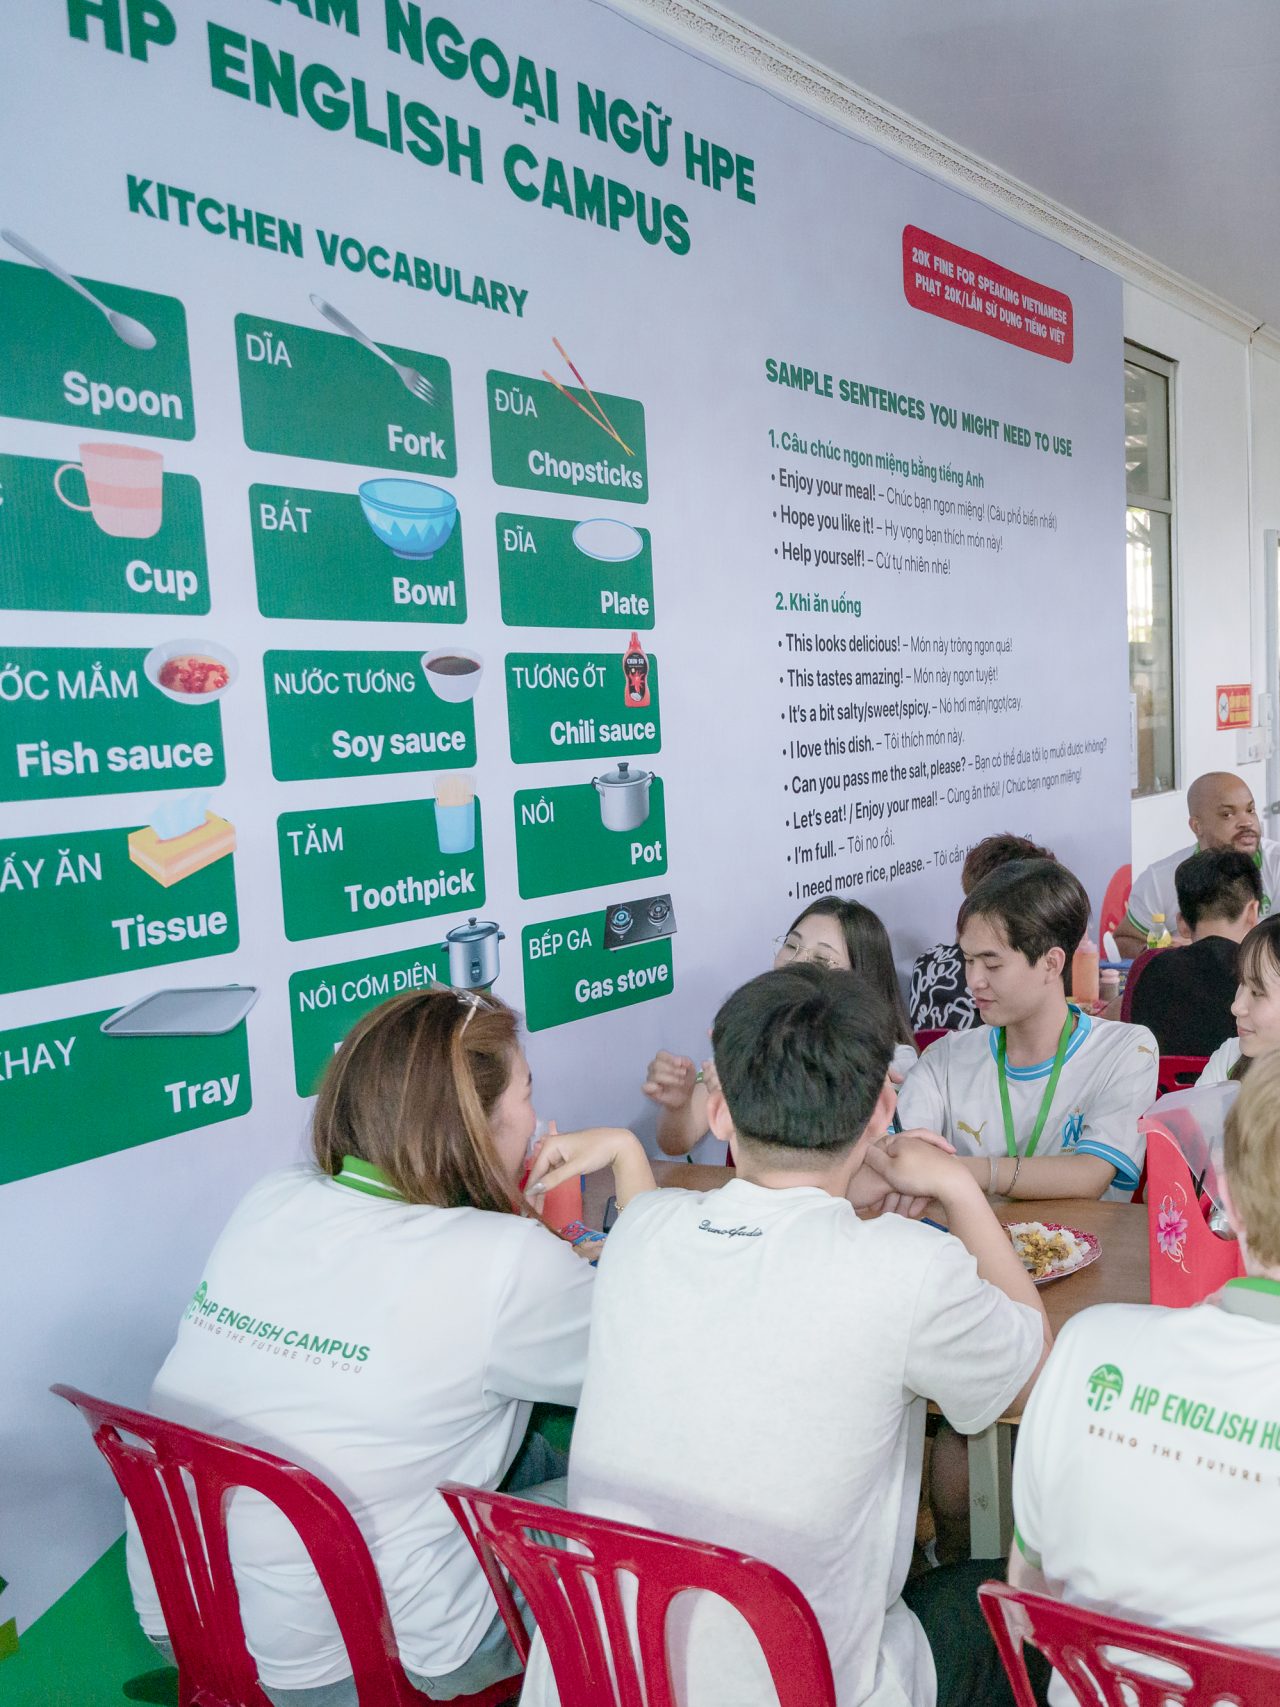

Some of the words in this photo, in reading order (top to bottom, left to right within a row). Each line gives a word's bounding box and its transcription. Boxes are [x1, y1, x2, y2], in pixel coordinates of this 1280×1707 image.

[384, 0, 559, 127] NGOẠI
[577, 80, 673, 168] NGỮ
[685, 131, 757, 205] HPE
[67, 0, 177, 63] HP
[207, 20, 484, 185] ENGLISH
[503, 143, 692, 257] CAMPUS
[125, 173, 305, 260] KITCHEN
[316, 229, 529, 318] VOCABULARY
[912, 247, 930, 268] 20K
[934, 255, 954, 278] FINE
[957, 266, 975, 287] FOR
[978, 274, 1019, 305] SPEAKING
[1022, 294, 1067, 325] VIETNAMESE
[915, 273, 941, 297] PHẠT
[1000, 307, 1022, 329] DỤNG
[1024, 316, 1047, 338] TIẾNG
[246, 328, 292, 369] DĨA
[63, 370, 183, 421] Spoon
[494, 387, 538, 419] ĐŨA
[765, 358, 833, 398] SAMPLE
[839, 378, 925, 421] SENTENCES
[930, 402, 957, 429] YOU
[962, 412, 999, 439] MIGHT
[1004, 423, 1031, 448] NEED
[1035, 431, 1049, 452] TO
[1053, 435, 1072, 457] USE
[387, 424, 446, 461] Fork
[781, 431, 807, 455] Câu
[810, 439, 841, 462] chúc
[844, 448, 873, 468] ngon
[875, 452, 909, 477] miệng
[911, 455, 937, 483] bằng
[939, 462, 963, 488] tiếng
[966, 470, 984, 488] Anh
[528, 449, 643, 491] Chopsticks
[779, 467, 813, 495] Enjoy
[816, 478, 842, 497] your
[845, 484, 876, 501] meal!
[260, 499, 312, 534] BÁT
[781, 504, 814, 530] Hope
[817, 514, 839, 532] you
[841, 513, 861, 533] like
[863, 516, 874, 534] it!
[503, 528, 537, 554] ĐĨA
[782, 541, 811, 566] Help
[814, 548, 865, 568] yourself!
[125, 560, 198, 601] Cup
[392, 576, 456, 607] Bowl
[601, 590, 649, 616] Plate
[790, 592, 811, 612] Khi
[813, 593, 829, 612] ăn
[831, 591, 862, 618] uống
[786, 633, 813, 651] This
[815, 634, 847, 652] looks
[849, 634, 900, 652] delicious!
[57, 661, 139, 699] MẮM
[274, 665, 340, 696] NƯỚC
[343, 668, 415, 694] TƯƠNG
[512, 665, 579, 689] TƯƠNG
[583, 663, 607, 688] ỚT
[787, 668, 814, 687] This
[816, 669, 853, 687] tastes
[855, 667, 903, 688] amazing!
[809, 709, 817, 722] a
[819, 703, 834, 721] bit
[332, 729, 385, 762] Soy
[390, 729, 466, 756] sauce
[550, 719, 595, 746] Chili
[599, 722, 655, 743] sauce
[796, 740, 822, 758] love
[824, 737, 846, 755] this
[848, 735, 875, 754] dish.
[16, 740, 99, 777] Fish
[107, 742, 214, 772] sauce
[791, 775, 817, 794] Can
[819, 775, 840, 794] you
[843, 772, 869, 791] pass
[871, 769, 888, 784] me
[890, 764, 907, 781] the
[909, 761, 929, 780] salt,
[930, 756, 966, 779] please?
[521, 796, 555, 825] NỒI
[824, 804, 847, 823] eat!
[855, 802, 884, 821] Enjoy
[887, 798, 910, 817] your
[911, 790, 938, 810] meal!
[287, 826, 344, 856] TĂM
[630, 840, 662, 866] Pot
[815, 840, 837, 860] full.
[55, 848, 102, 886] ĂN
[802, 875, 832, 899] need
[835, 873, 863, 891] more
[866, 865, 889, 883] rice,
[890, 859, 925, 882] please.
[344, 867, 475, 913] Toothpick
[111, 911, 228, 950] Tissue
[528, 930, 564, 960] BẾP
[566, 928, 592, 951] GA
[299, 976, 338, 1012] NỒI
[341, 973, 389, 1002] CƠM
[575, 978, 614, 1003] Gas
[616, 964, 668, 992] stove
[164, 1074, 240, 1113] Tray
[193, 1316, 222, 1335] BRING
[227, 1329, 246, 1344] THE
[251, 1339, 297, 1360] FUTURE
[304, 1354, 322, 1365] TO
[331, 1360, 363, 1374] YOU
[199, 1298, 218, 1317] HP
[216, 1307, 284, 1342] ENGLISH
[283, 1330, 371, 1362] CAMPUS
[1129, 1383, 1160, 1416] HP
[1161, 1393, 1260, 1446] ENGLISH
[1088, 1424, 1138, 1449] BRING
[1152, 1443, 1182, 1462] THE
[1196, 1456, 1263, 1483] FUTURE
